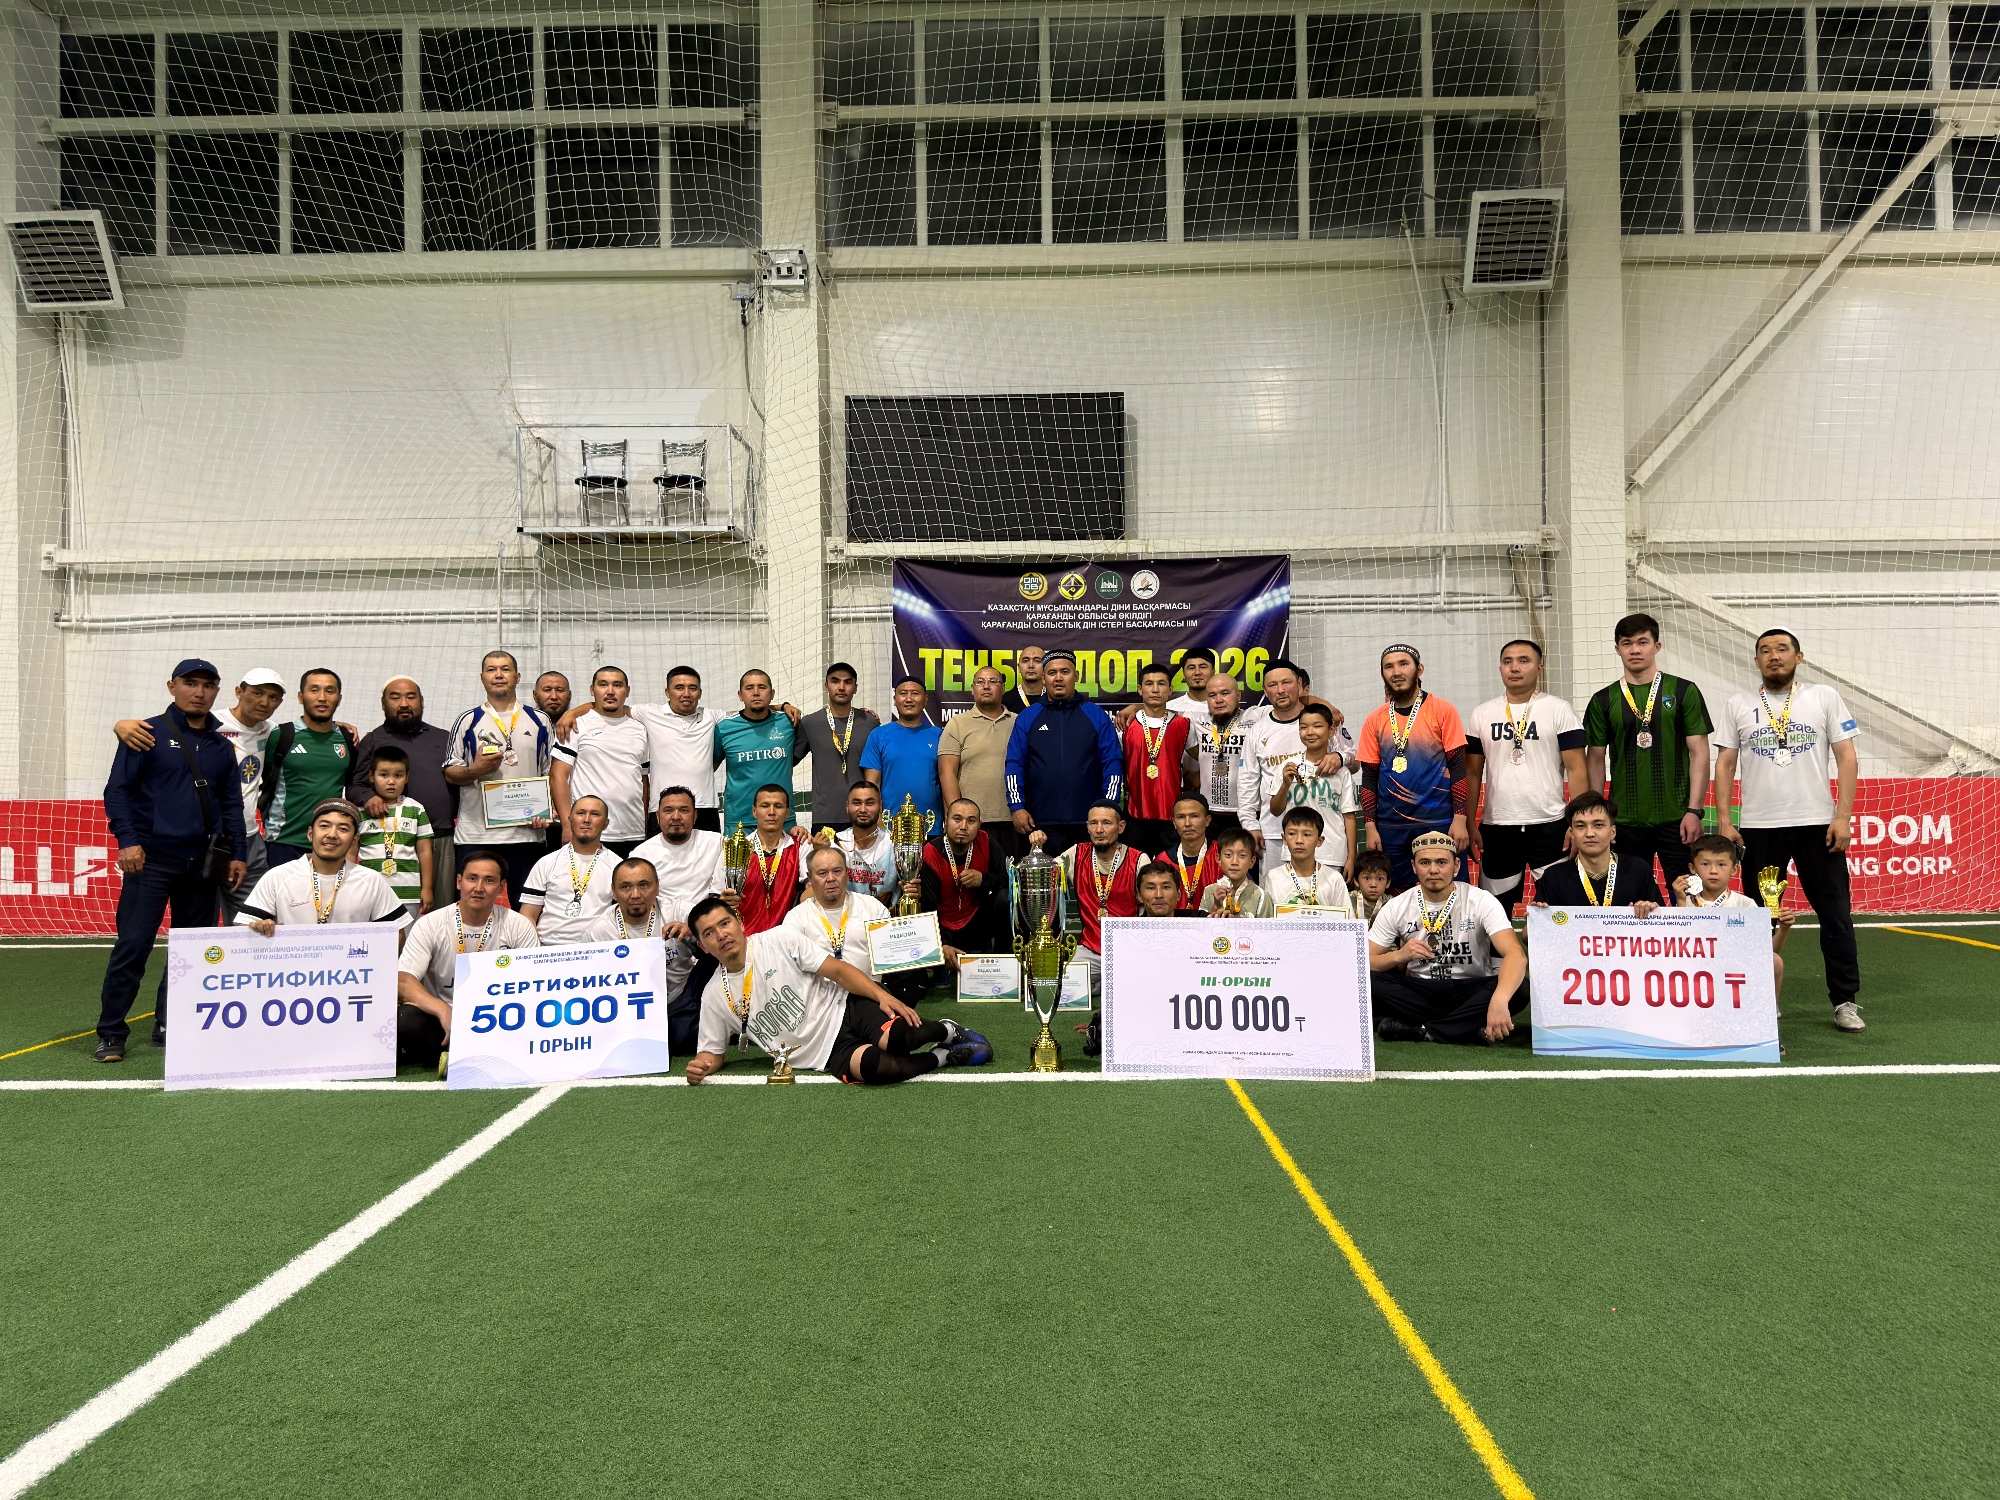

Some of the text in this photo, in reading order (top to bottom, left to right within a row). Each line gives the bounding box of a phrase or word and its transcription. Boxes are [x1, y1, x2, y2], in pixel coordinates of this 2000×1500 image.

[988, 604, 1035, 612] ҚАЗАҚСТАН
[1111, 604, 1131, 612] ДІНИ
[1133, 603, 1191, 611] БАСҚАРМАСЫ
[1026, 613, 1076, 621] ҚАРАҒАНДЫ
[1033, 622, 1082, 630] ОБЛЫСТЫҚ
[1083, 621, 1097, 630] ДІН
[1126, 621, 1182, 629] БАСҚАРМАСЫ
[1073, 649, 1153, 698] ДОП
[1169, 647, 1271, 692] 226
[1753, 707, 1760, 723] 1
[1886, 857, 1958, 876] CORP.
[1579, 935, 1717, 959] СЕРТИФИКАТ
[202, 968, 374, 991] СЕРТИФИКАТ
[486, 971, 641, 996] СЕРТИФИКАТ
[1562, 968, 1631, 1006] 200
[1644, 969, 1714, 1009] 000
[196, 1001, 248, 1030] 70
[261, 996, 341, 1027] 000
[470, 1002, 526, 1033] 50
[535, 994, 619, 1028] 000
[1169, 993, 1222, 1030] 100
[1231, 995, 1290, 1032] 000
[539, 1035, 592, 1053] ОРЫН
